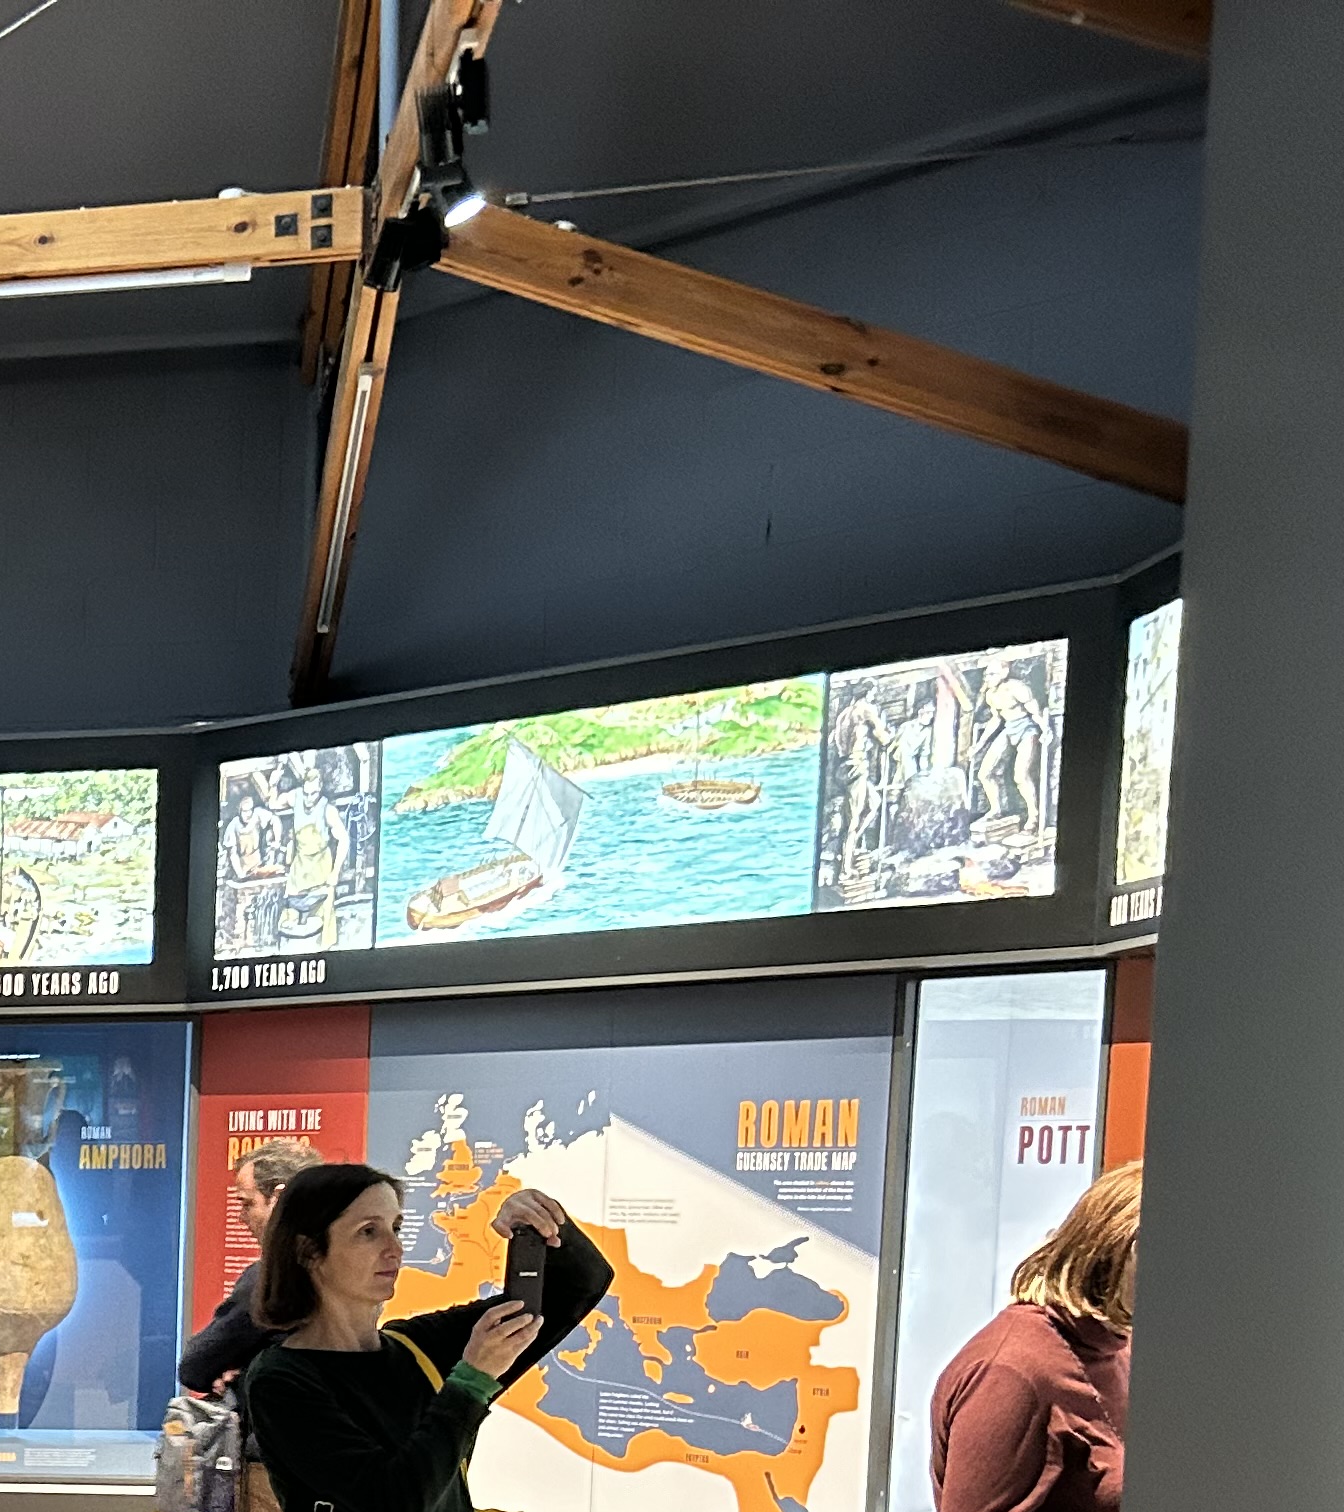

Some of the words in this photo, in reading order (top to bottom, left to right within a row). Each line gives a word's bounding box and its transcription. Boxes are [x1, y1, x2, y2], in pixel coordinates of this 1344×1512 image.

[32, 972, 81, 996] YEARS
[88, 971, 119, 994] AGO
[212, 965, 249, 991] 1,700
[255, 962, 295, 987] YEARS
[300, 960, 325, 984] AGO
[1020, 1096, 1066, 1116] ROMAN
[228, 1110, 264, 1131] LIVING
[268, 1109, 296, 1130] WITH
[301, 1108, 322, 1130] THE
[737, 1099, 859, 1148] ROMAN
[81, 1126, 112, 1140] ROMAN
[1017, 1125, 1091, 1165] POTT
[79, 1144, 167, 1170] AMPHORA
[736, 1152, 790, 1171] GUERNSEY
[794, 1152, 828, 1170] TRADE
[831, 1151, 857, 1170] MAP
